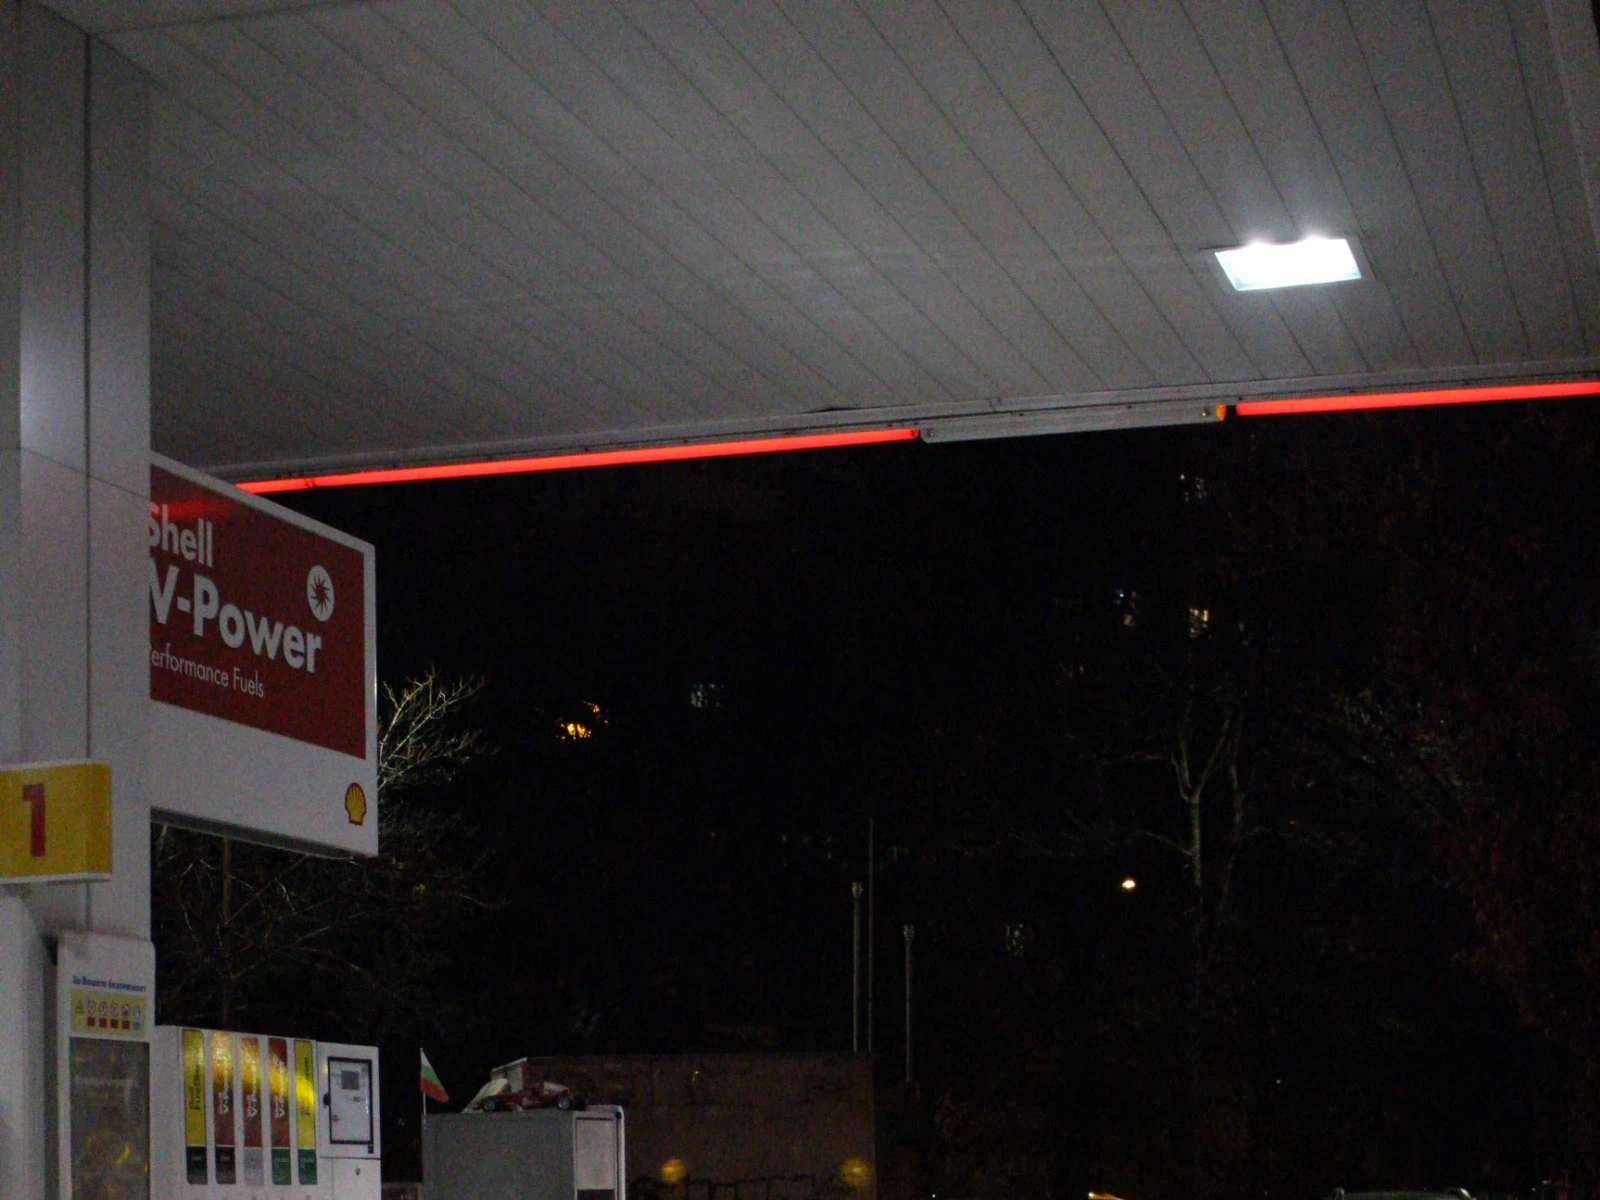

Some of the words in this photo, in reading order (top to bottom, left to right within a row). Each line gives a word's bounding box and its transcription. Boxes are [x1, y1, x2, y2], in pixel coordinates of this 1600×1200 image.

[150, 502, 213, 567] Shell
[150, 557, 322, 674] V-Power
[150, 641, 229, 687] erformance
[233, 665, 264, 698] Fuels
[22, 783, 46, 858] 1
